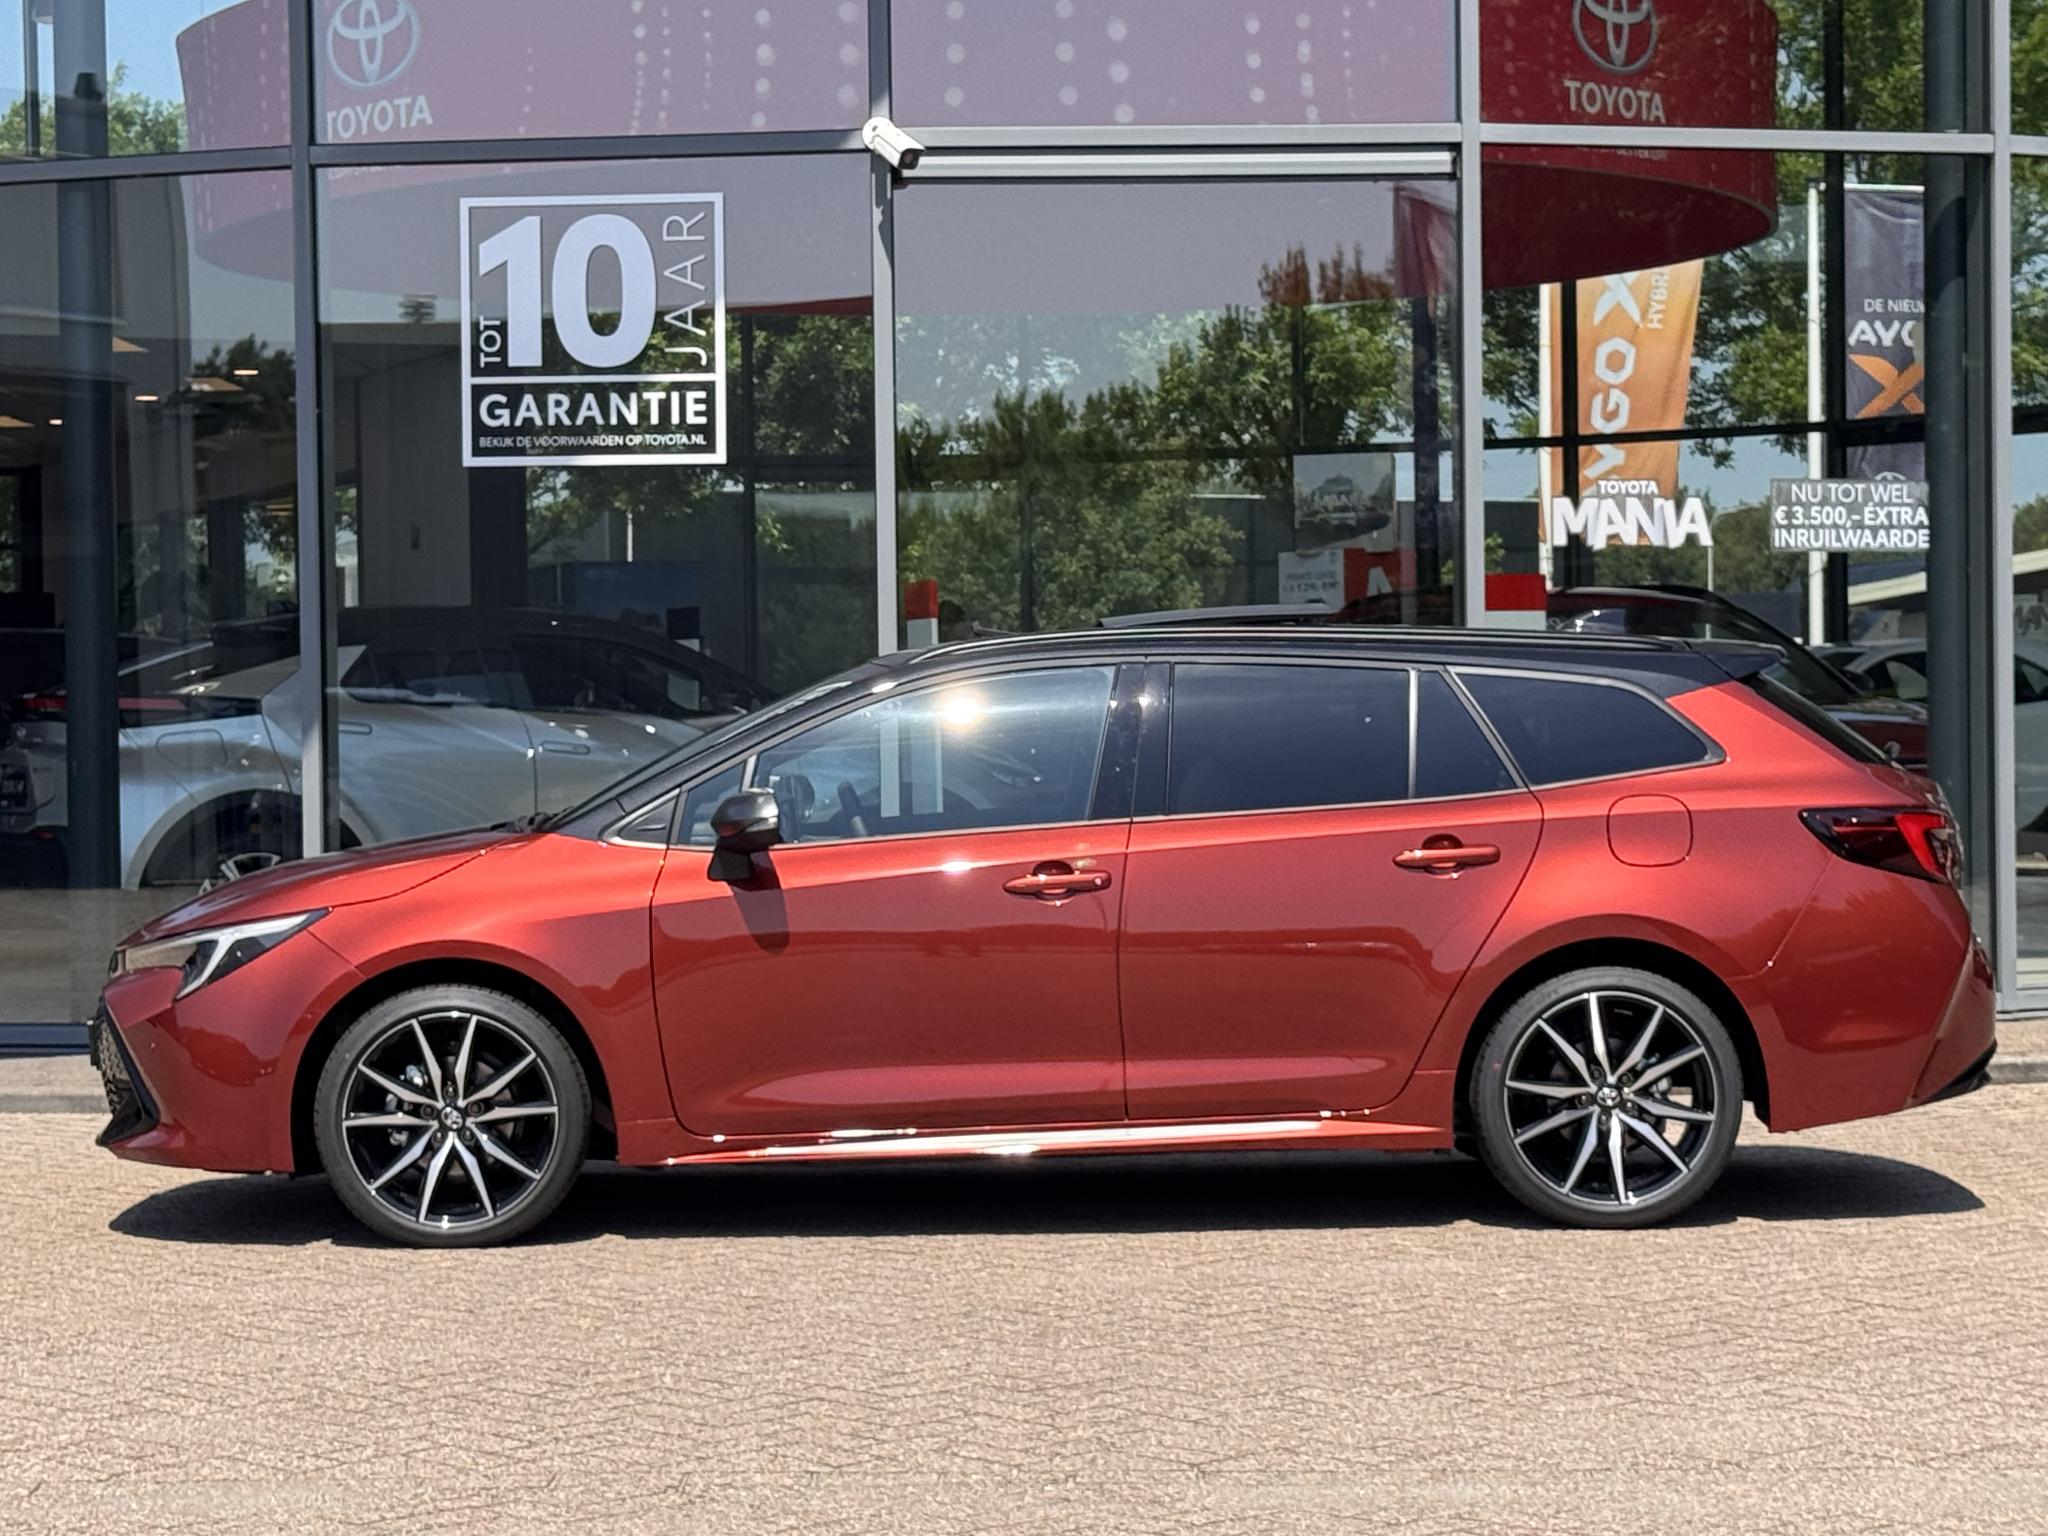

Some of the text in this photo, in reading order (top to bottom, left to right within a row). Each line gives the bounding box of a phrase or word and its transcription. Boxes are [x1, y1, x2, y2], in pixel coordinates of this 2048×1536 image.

[326, 95, 434, 142] TOYOTA
[1563, 79, 1666, 124] TOYOTA
[479, 213, 657, 369] 10
[662, 211, 708, 366] JAAR
[1864, 298, 1885, 313] DE
[479, 315, 502, 369] TOT
[479, 391, 708, 427] GARANTIE
[1582, 336, 1636, 498] YGO
[516, 435, 532, 448] DE
[533, 434, 624, 447] VOORWAARDEN
[625, 434, 643, 447] OP
[645, 432, 708, 446] TOYOTA.NL
[1598, 480, 1659, 495] TOYOTA
[1791, 483, 1915, 504] NU TOT WEL
[1552, 497, 1714, 551] MANIA
[1774, 505, 1789, 526] €
[1774, 527, 1931, 549] INRUILWAARDE
